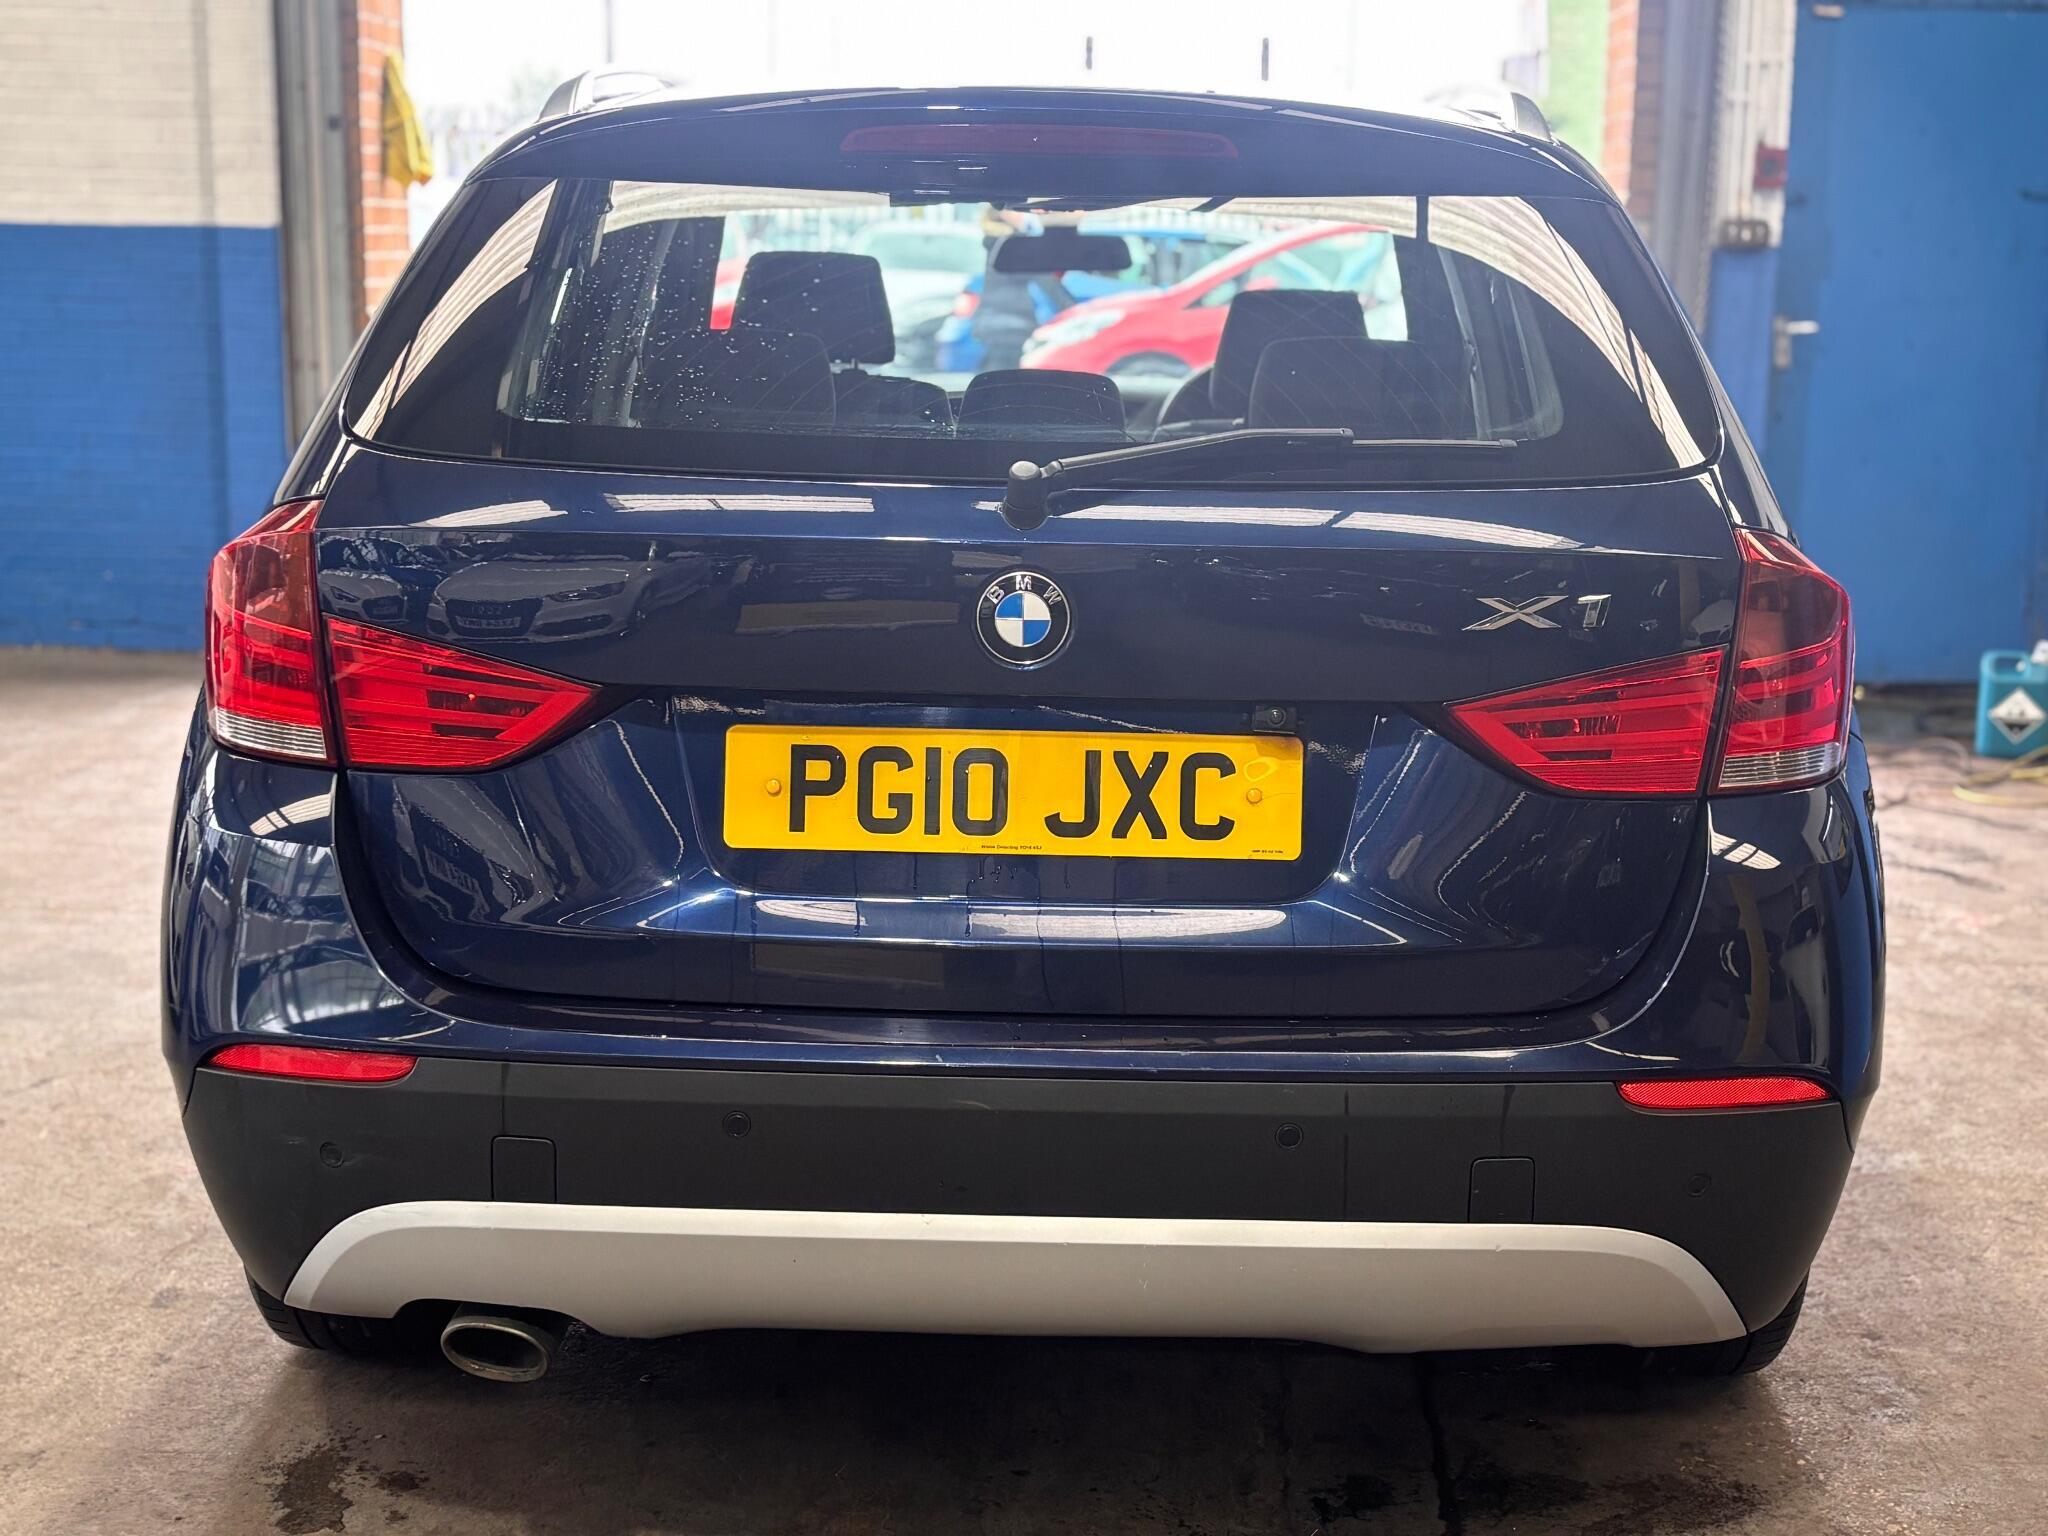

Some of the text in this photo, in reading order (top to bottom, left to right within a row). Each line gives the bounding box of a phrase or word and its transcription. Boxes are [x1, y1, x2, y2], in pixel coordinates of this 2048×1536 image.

[986, 575, 1062, 605] BMW
[1461, 593, 1612, 631] X1
[789, 744, 1236, 841] PG10 JXC
